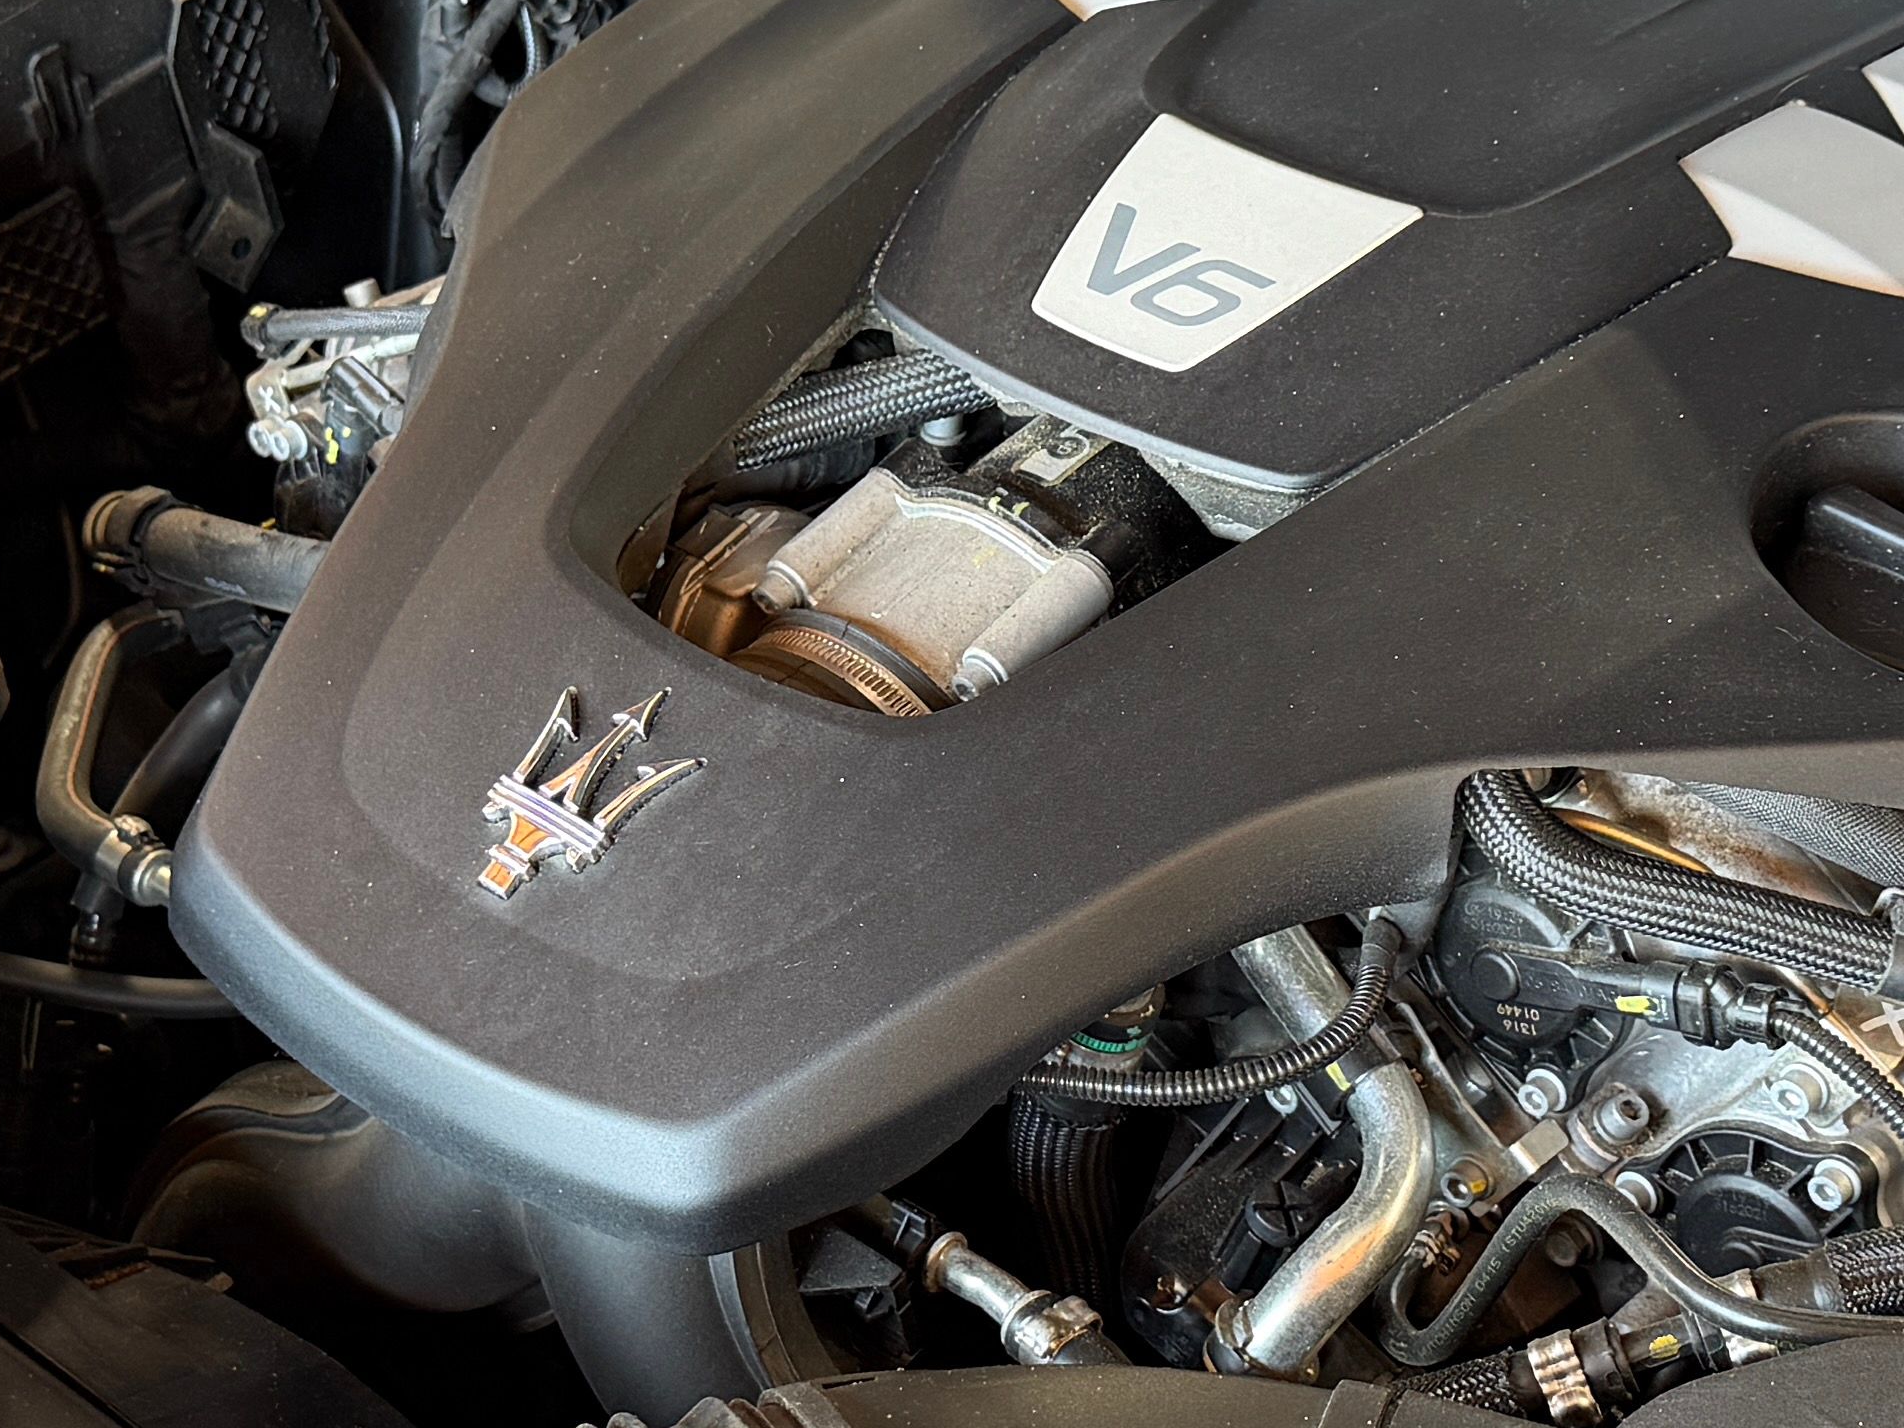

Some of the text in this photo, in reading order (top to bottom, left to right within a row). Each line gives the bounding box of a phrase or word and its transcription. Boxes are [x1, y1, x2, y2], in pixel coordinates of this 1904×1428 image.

[1086, 202, 1277, 327] V6
[1496, 1002, 1540, 1022] 01449
[1502, 1018, 1538, 1037] 1316
